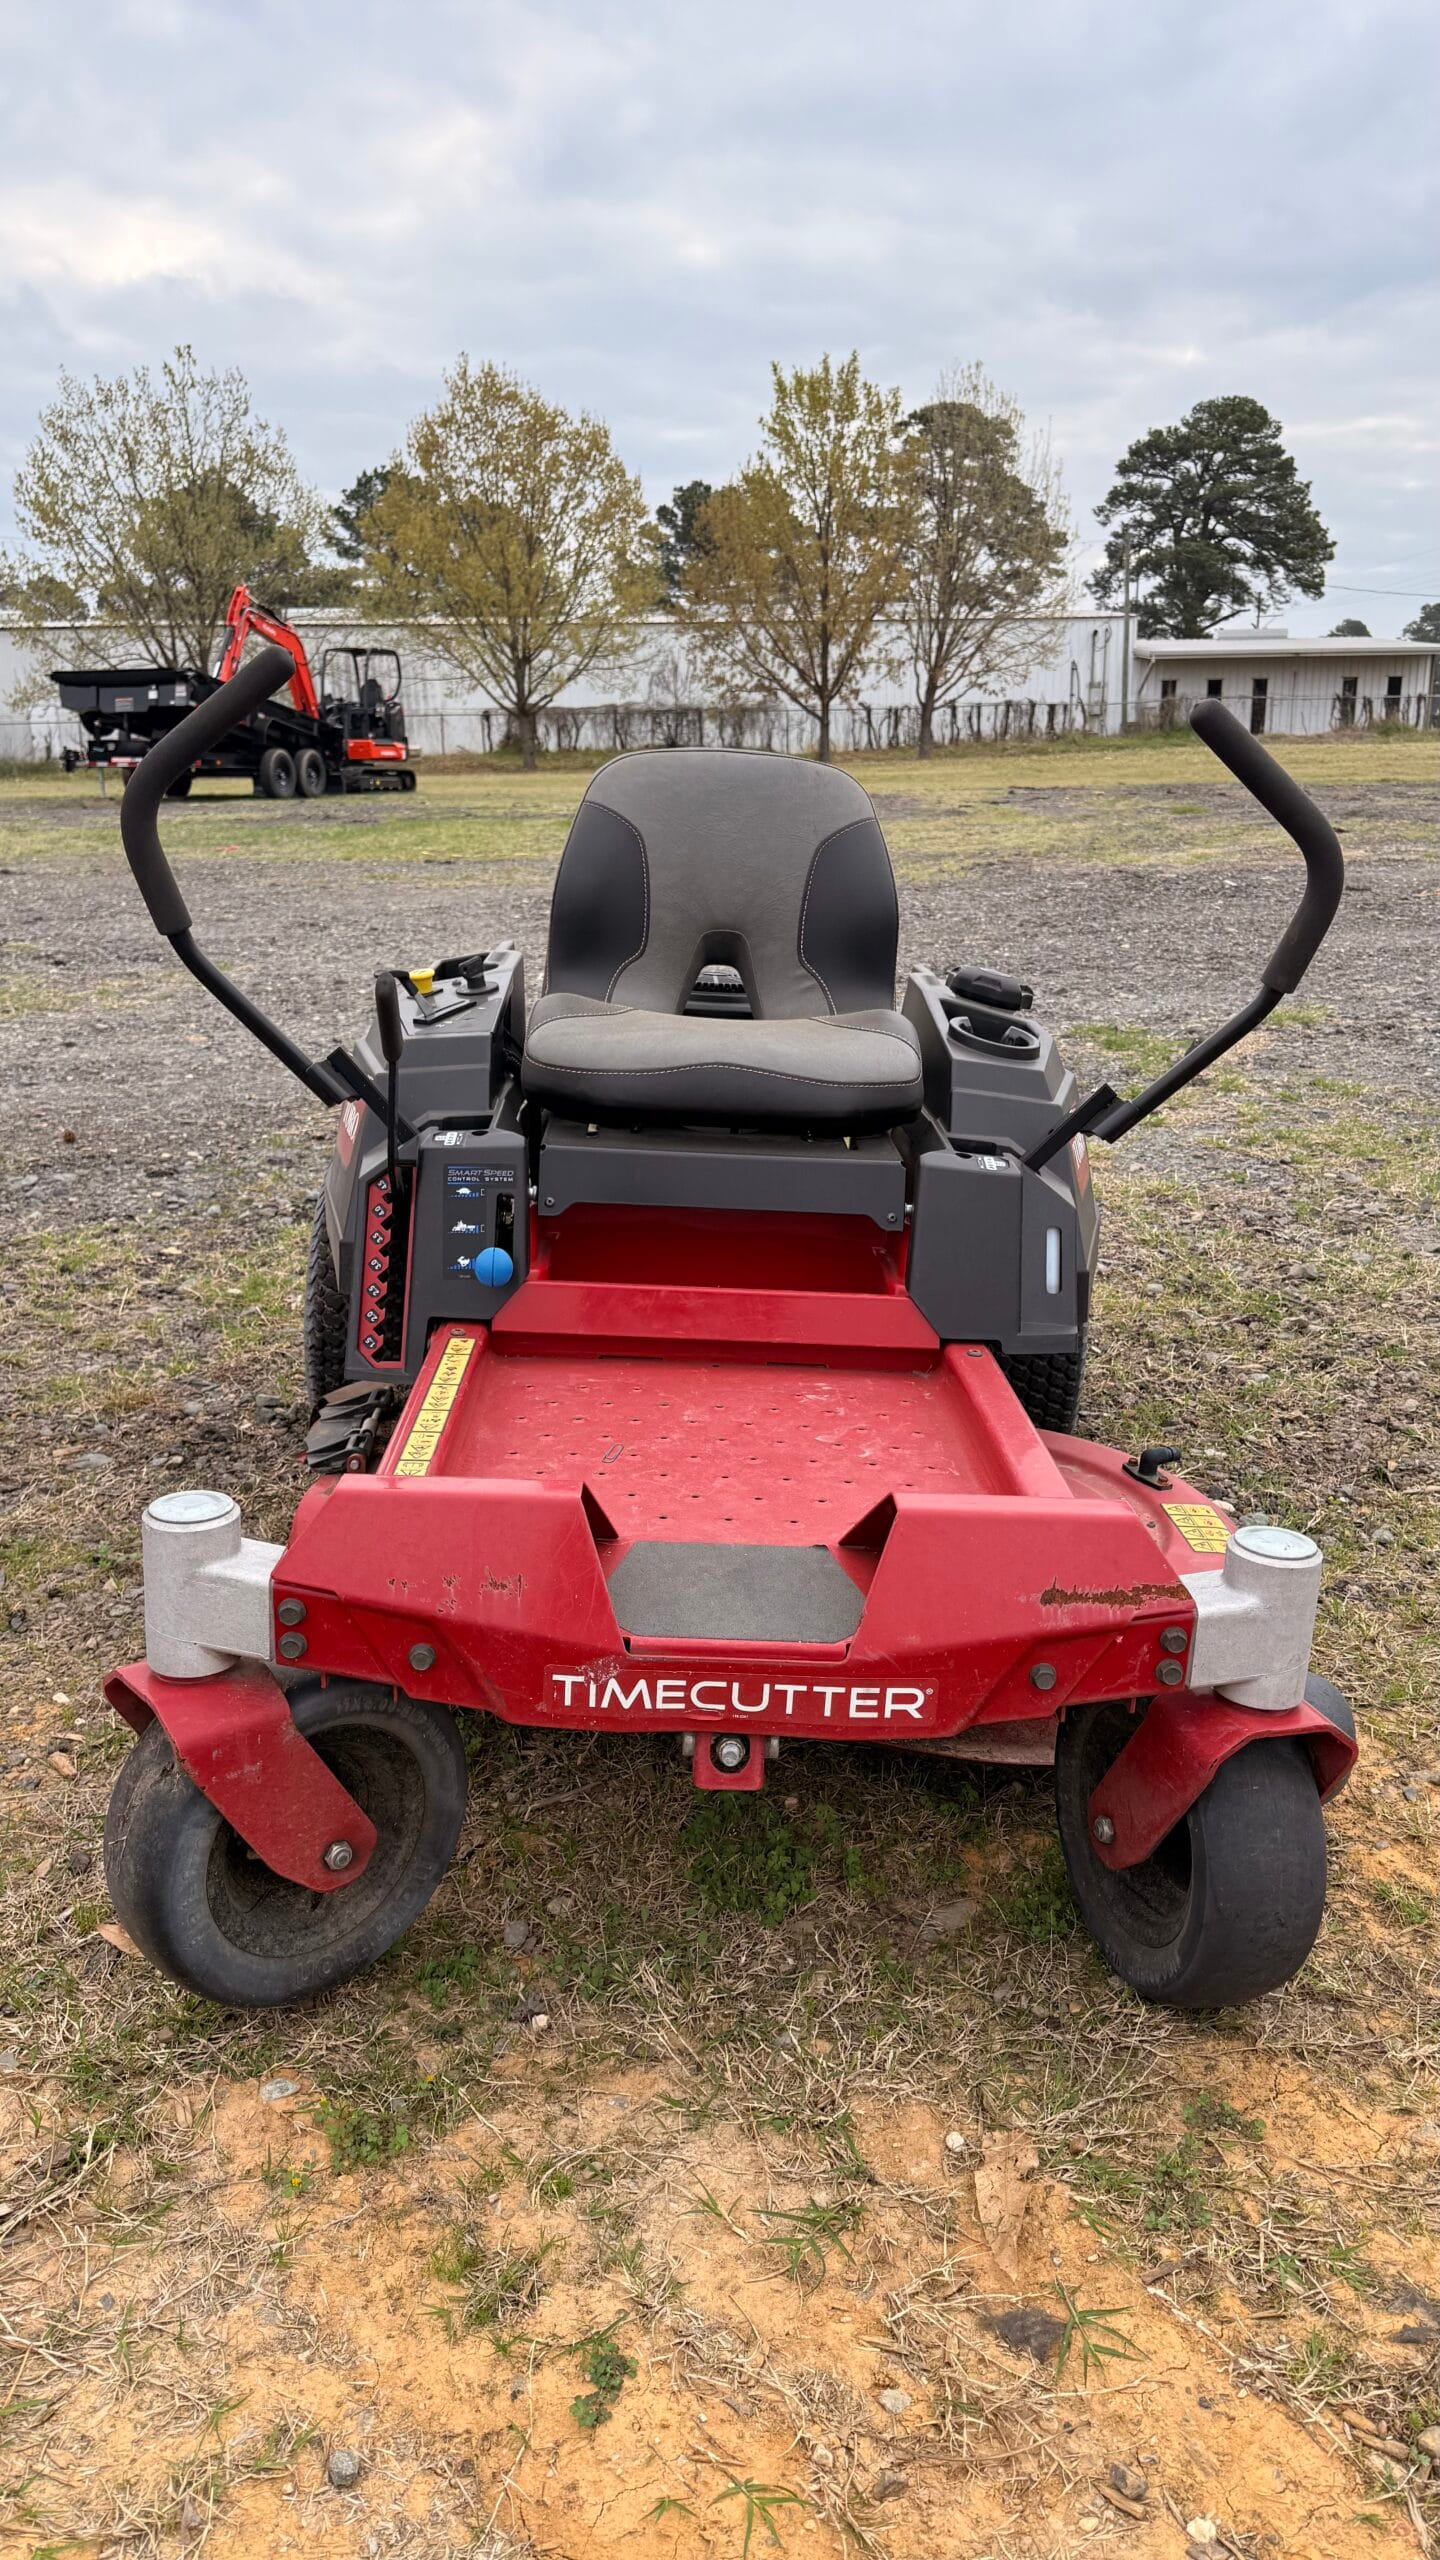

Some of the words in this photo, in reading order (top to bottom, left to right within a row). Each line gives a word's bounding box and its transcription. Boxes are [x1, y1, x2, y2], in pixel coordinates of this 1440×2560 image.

[374, 1206, 385, 1216] 4.0
[372, 1232, 383, 1243] 3.5
[370, 1259, 381, 1270] 3.0
[368, 1285, 380, 1296] 2.5
[366, 1311, 378, 1322] 2.0
[364, 1337, 375, 1348] 1.5
